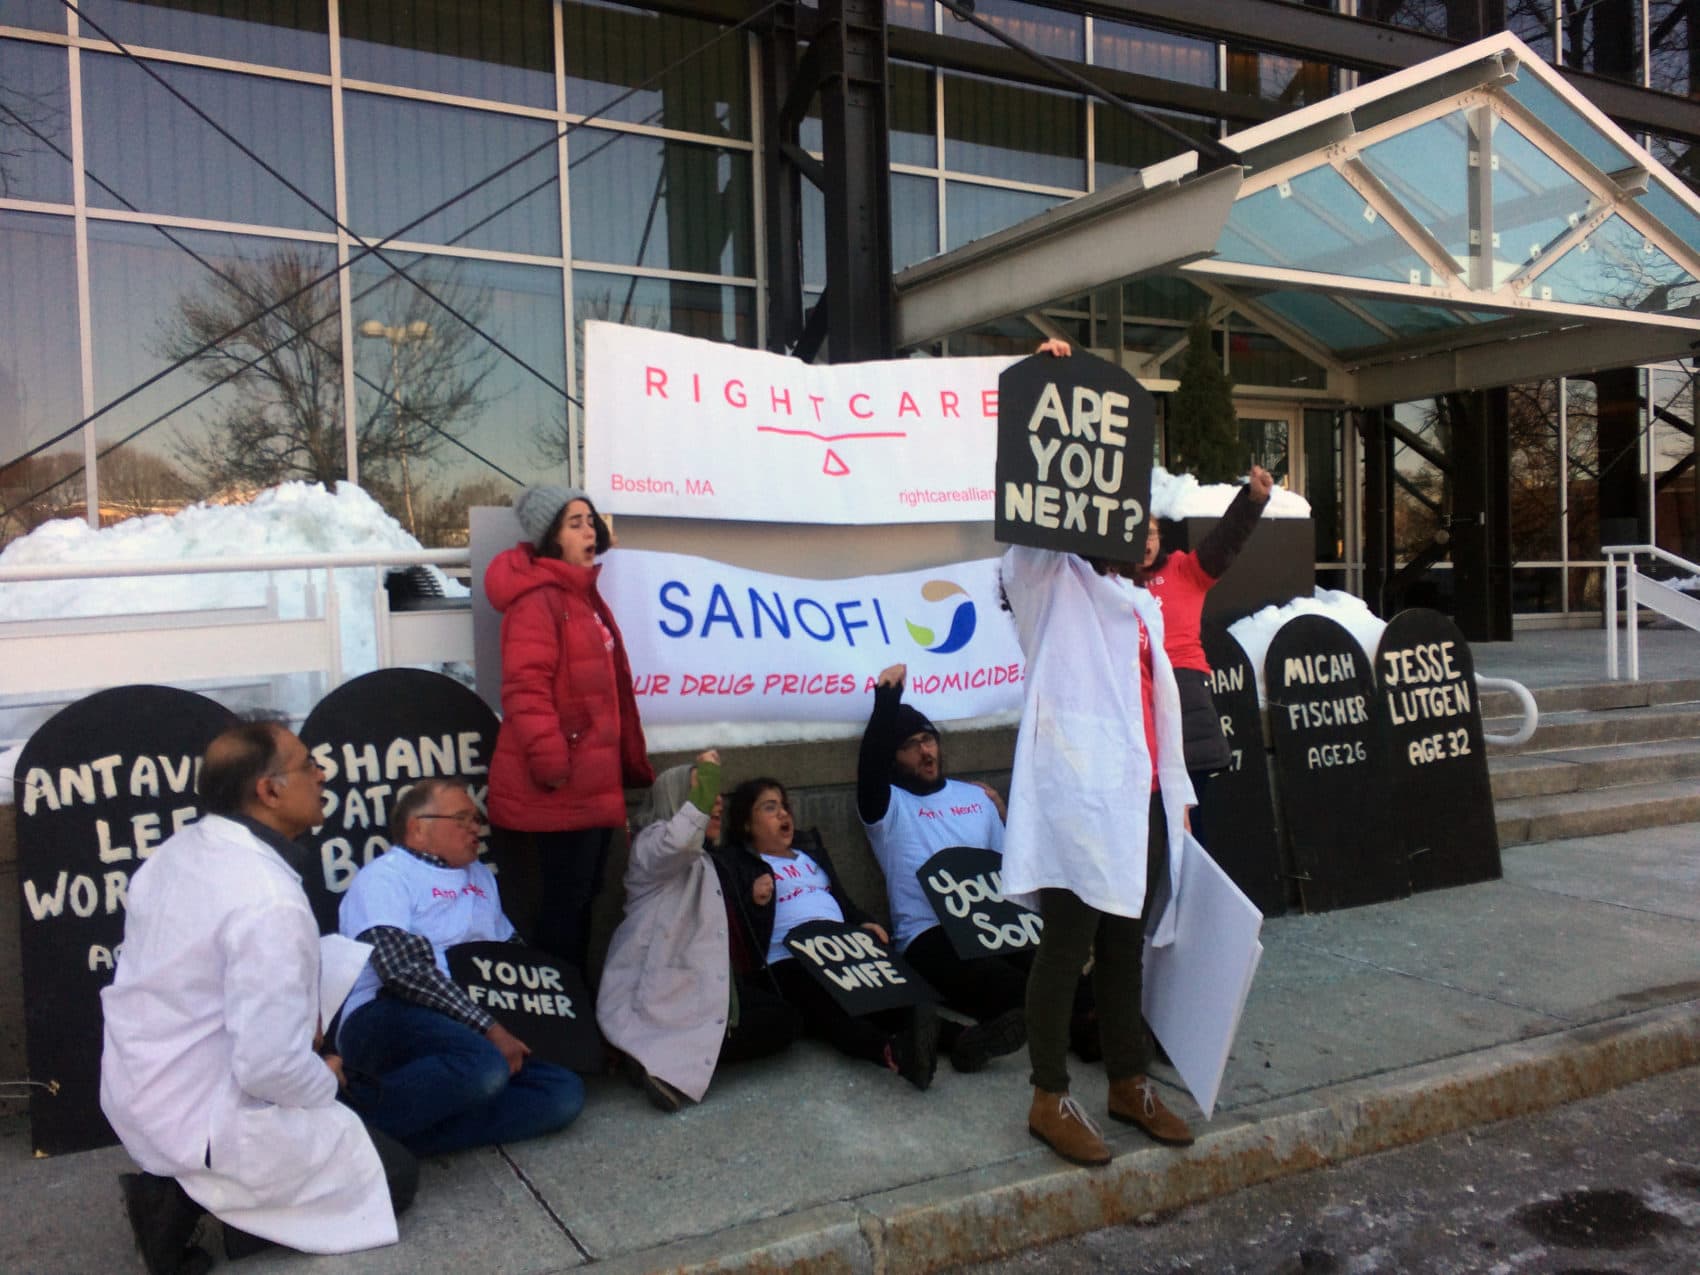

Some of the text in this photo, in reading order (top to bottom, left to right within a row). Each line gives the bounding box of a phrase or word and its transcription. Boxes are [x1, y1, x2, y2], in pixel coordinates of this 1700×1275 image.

[1028, 382, 1129, 447] ARE
[1029, 434, 1123, 494] YOU
[610, 474, 715, 496] Boston, MA
[1005, 482, 1143, 542] NEXT?
[659, 581, 890, 647] SANOFI
[1284, 653, 1356, 687] MICAH
[1384, 641, 1461, 686] JESSE
[680, 673, 755, 697] DRUG
[763, 673, 857, 696] PRICES
[1388, 680, 1471, 725] LUTGEN
[1288, 695, 1368, 730] FISCHER
[311, 732, 488, 783] SHANE
[1408, 728, 1471, 766] AGE 32
[790, 932, 888, 966] YOUR
[472, 956, 564, 992] YOUR
[824, 961, 907, 991] WIFE
[468, 985, 576, 1019] FATHER
